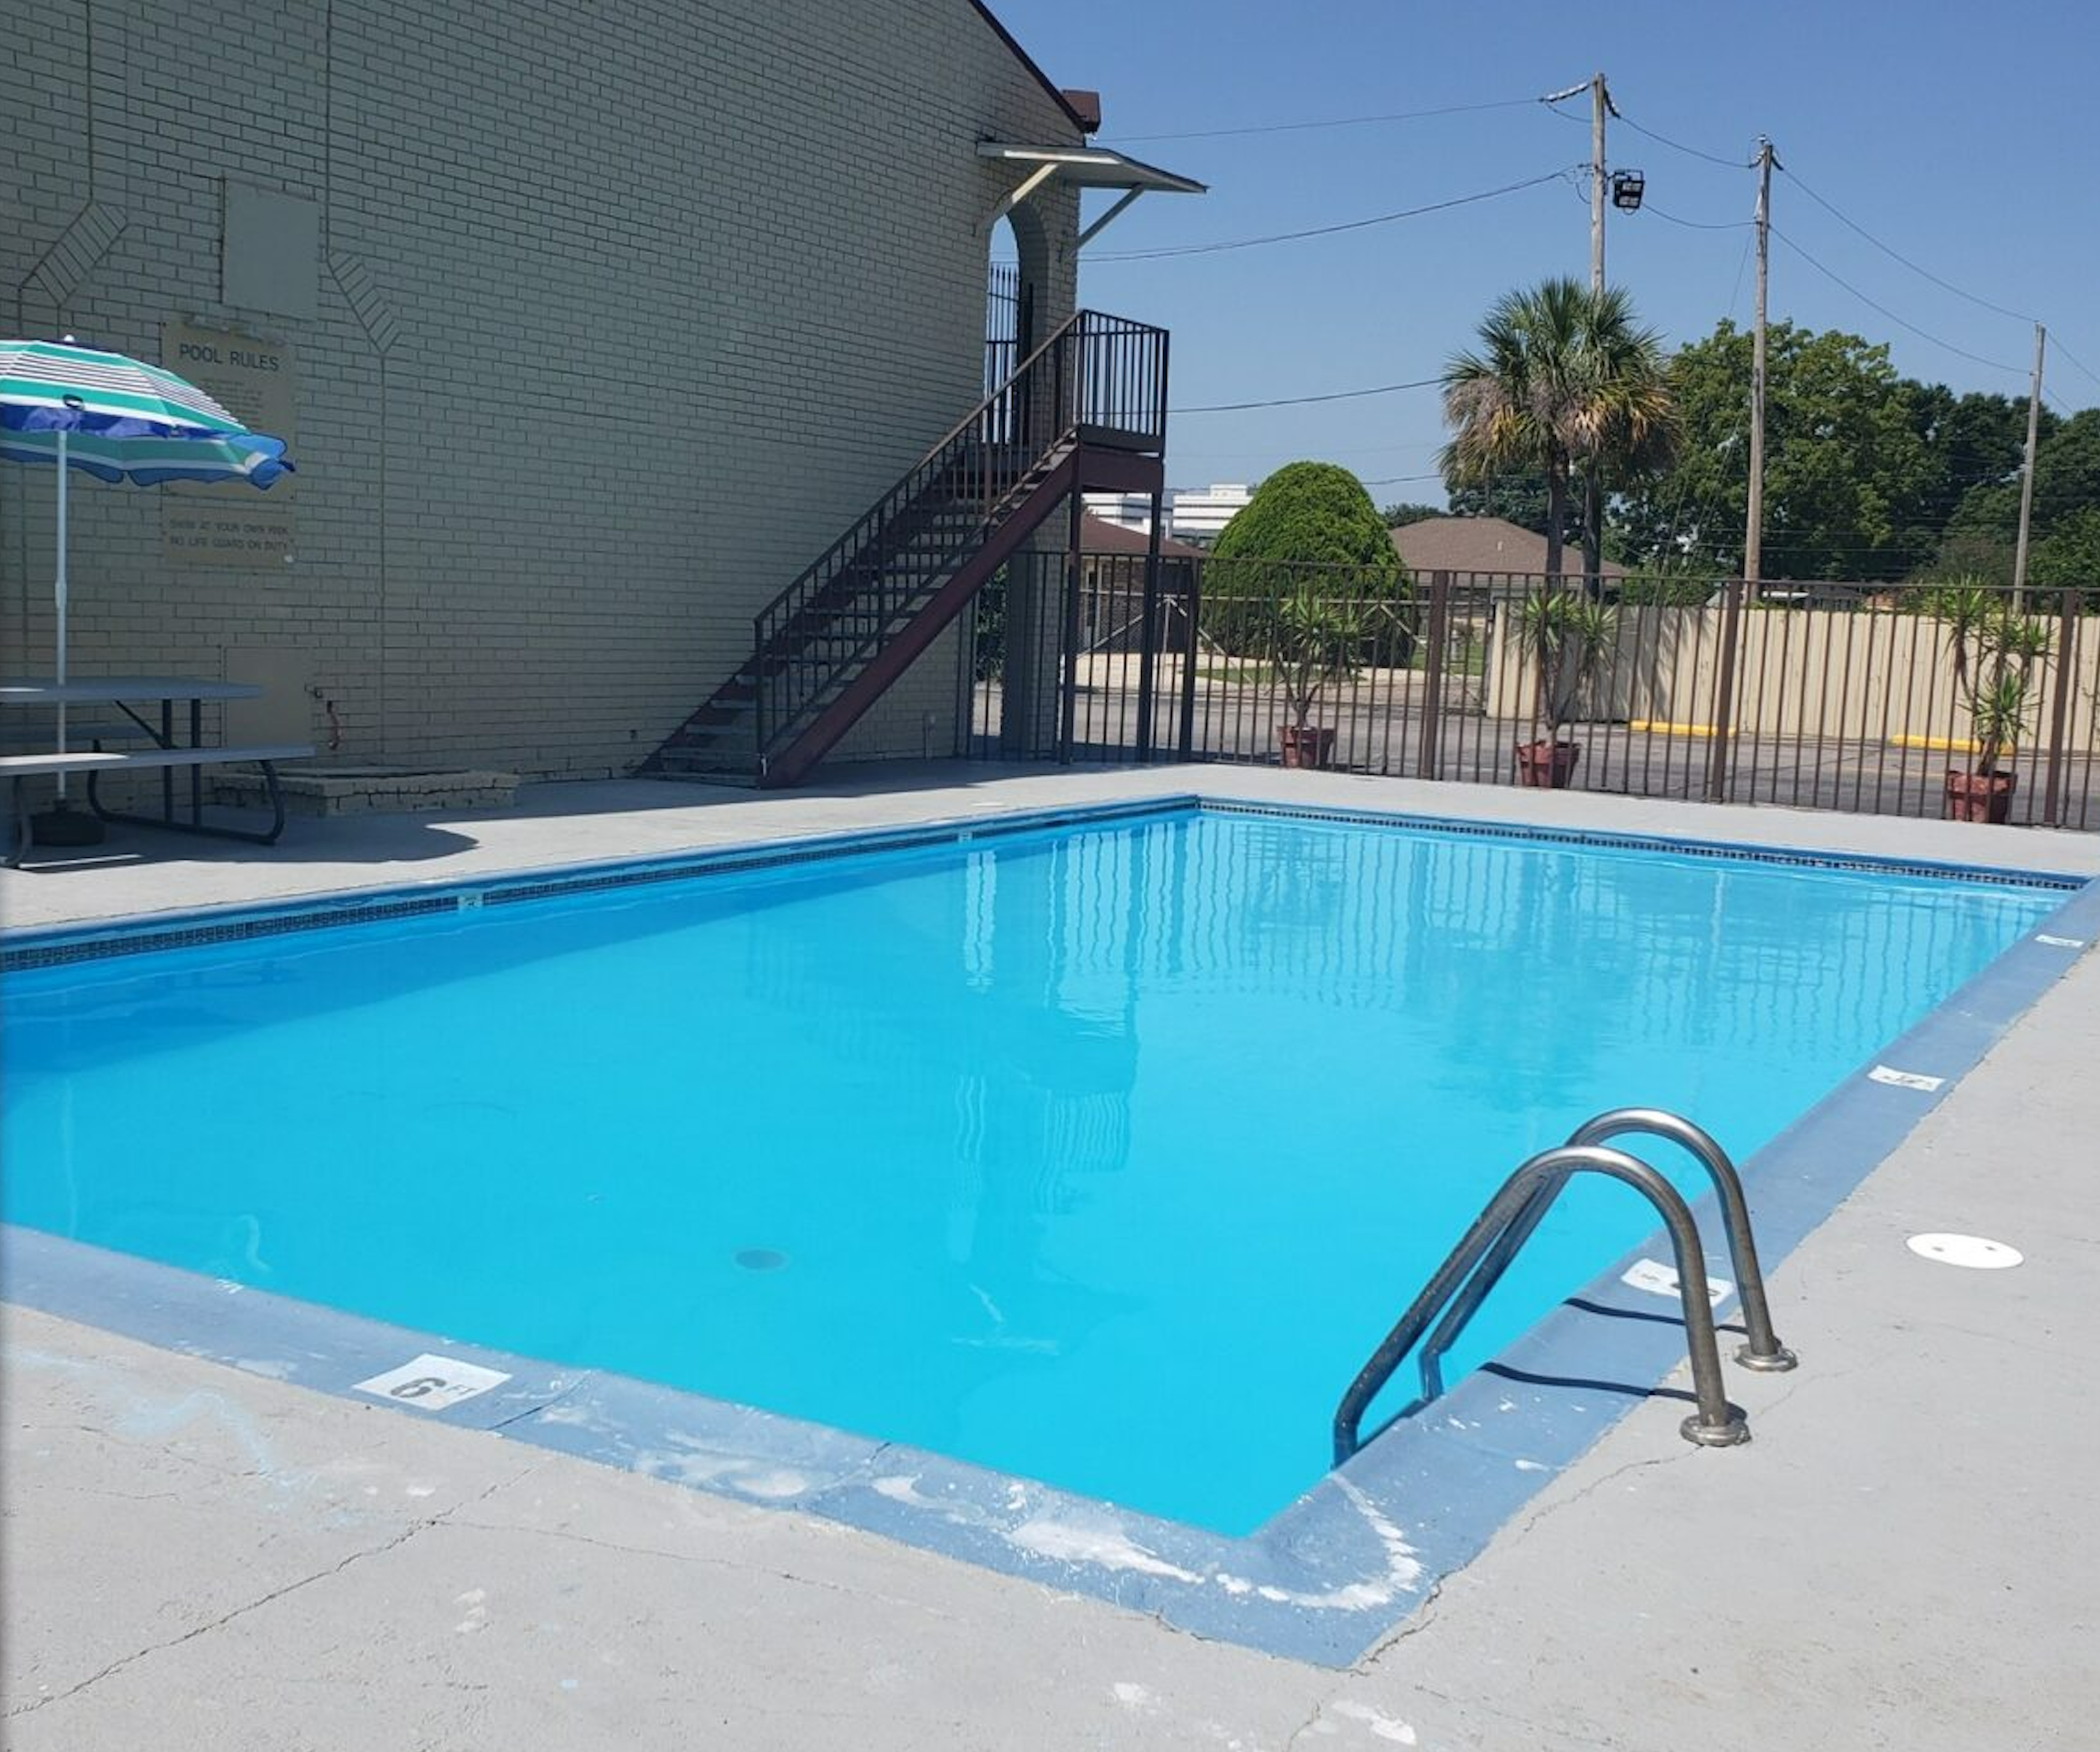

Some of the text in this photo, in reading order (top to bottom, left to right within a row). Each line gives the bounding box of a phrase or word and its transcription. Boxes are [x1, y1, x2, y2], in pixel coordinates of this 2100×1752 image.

[179, 343, 279, 372] POOL RULES
[214, 522, 240, 532] YOUR
[169, 535, 184, 546] NO
[188, 536, 208, 547] LIFE
[247, 540, 262, 550] ON
[390, 1377, 447, 1398] 6
